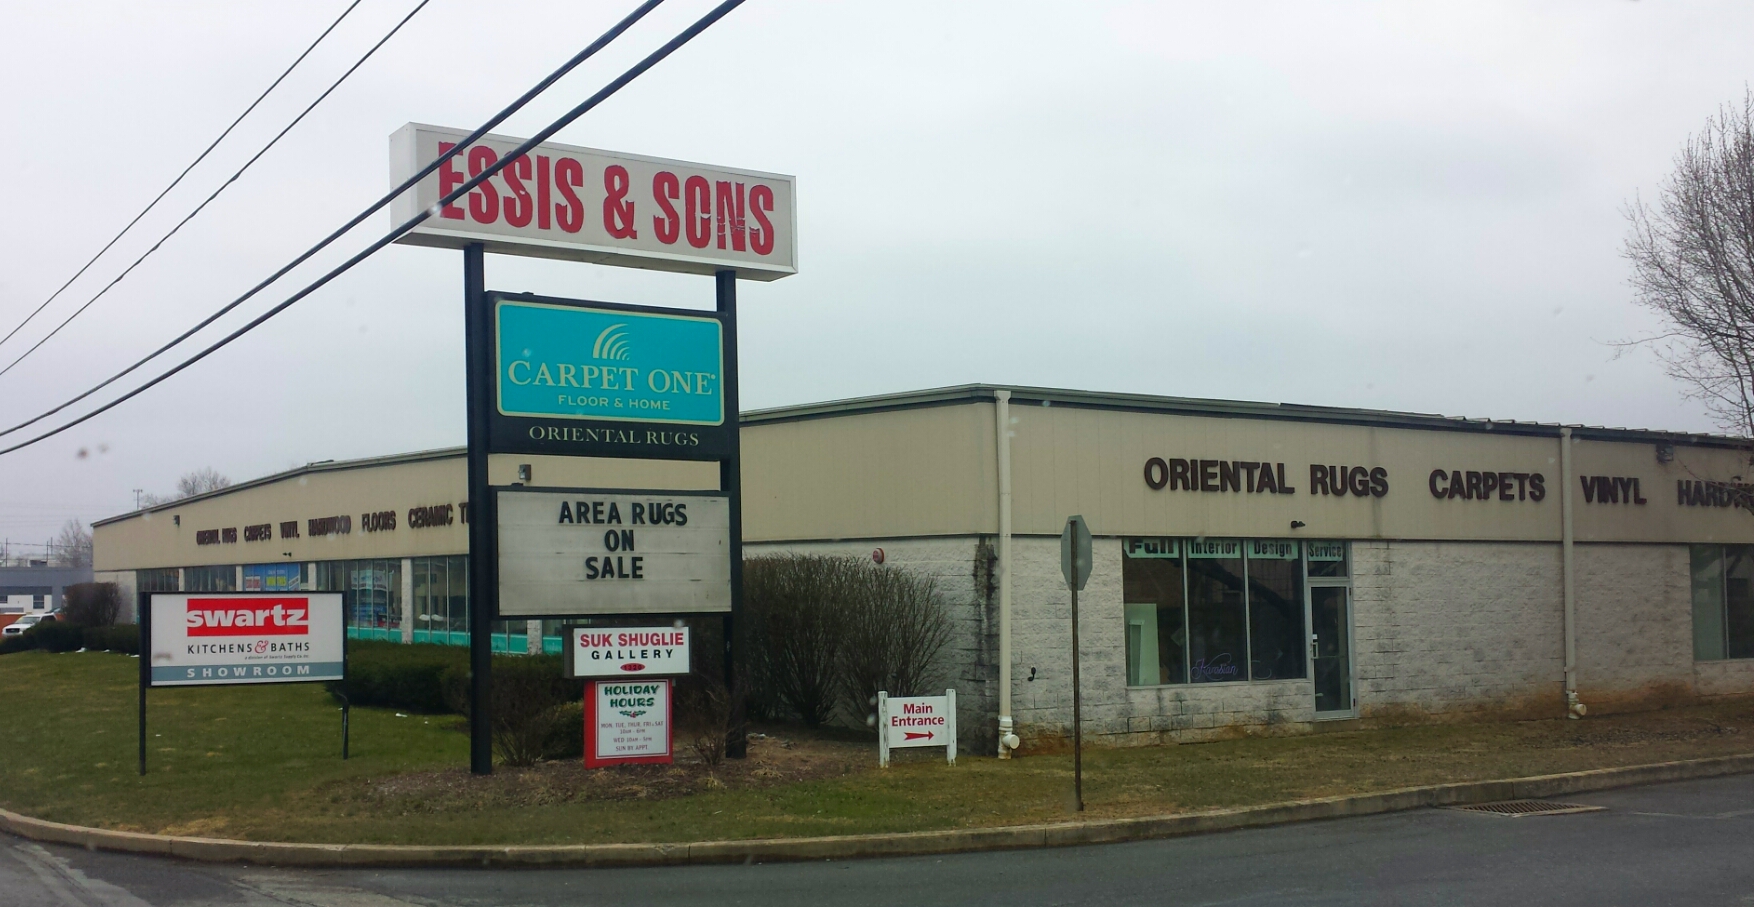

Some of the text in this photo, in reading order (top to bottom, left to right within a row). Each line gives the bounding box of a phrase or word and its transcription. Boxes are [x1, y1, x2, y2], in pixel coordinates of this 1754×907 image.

[439, 141, 774, 256] ESSIS & SONS
[508, 360, 638, 391] CARPET
[558, 395, 670, 410] FLOOR & HOME
[529, 425, 699, 446] ORIENTAL RUGS
[1144, 457, 1295, 494] ORIENTAL
[1310, 464, 1389, 498] RUGS
[1429, 469, 1545, 501] CARPETS
[1580, 475, 1647, 504] VINYL
[244, 523, 271, 542] CARPETS
[280, 521, 300, 539] VINYL
[308, 515, 351, 537] HARDWOOD
[362, 510, 397, 532] FLOORS
[408, 503, 453, 529] CERAMIC
[558, 501, 688, 526] AREA RUGS
[604, 529, 635, 552] ON
[1191, 539, 1237, 554] Interior
[1254, 540, 1292, 557] Design
[1309, 542, 1341, 557] Service
[585, 556, 644, 580] SALE
[187, 603, 308, 627] swartz
[187, 640, 310, 654] KITCHENS & BATHS
[580, 632, 684, 647] SUK SHUGLIE
[591, 649, 673, 660] GALLERY
[187, 665, 310, 678] SHOWROOM
[604, 685, 660, 696] HOLIDAY
[610, 697, 655, 708] HOURS
[904, 702, 933, 714] Main
[892, 716, 945, 727] Entrance
